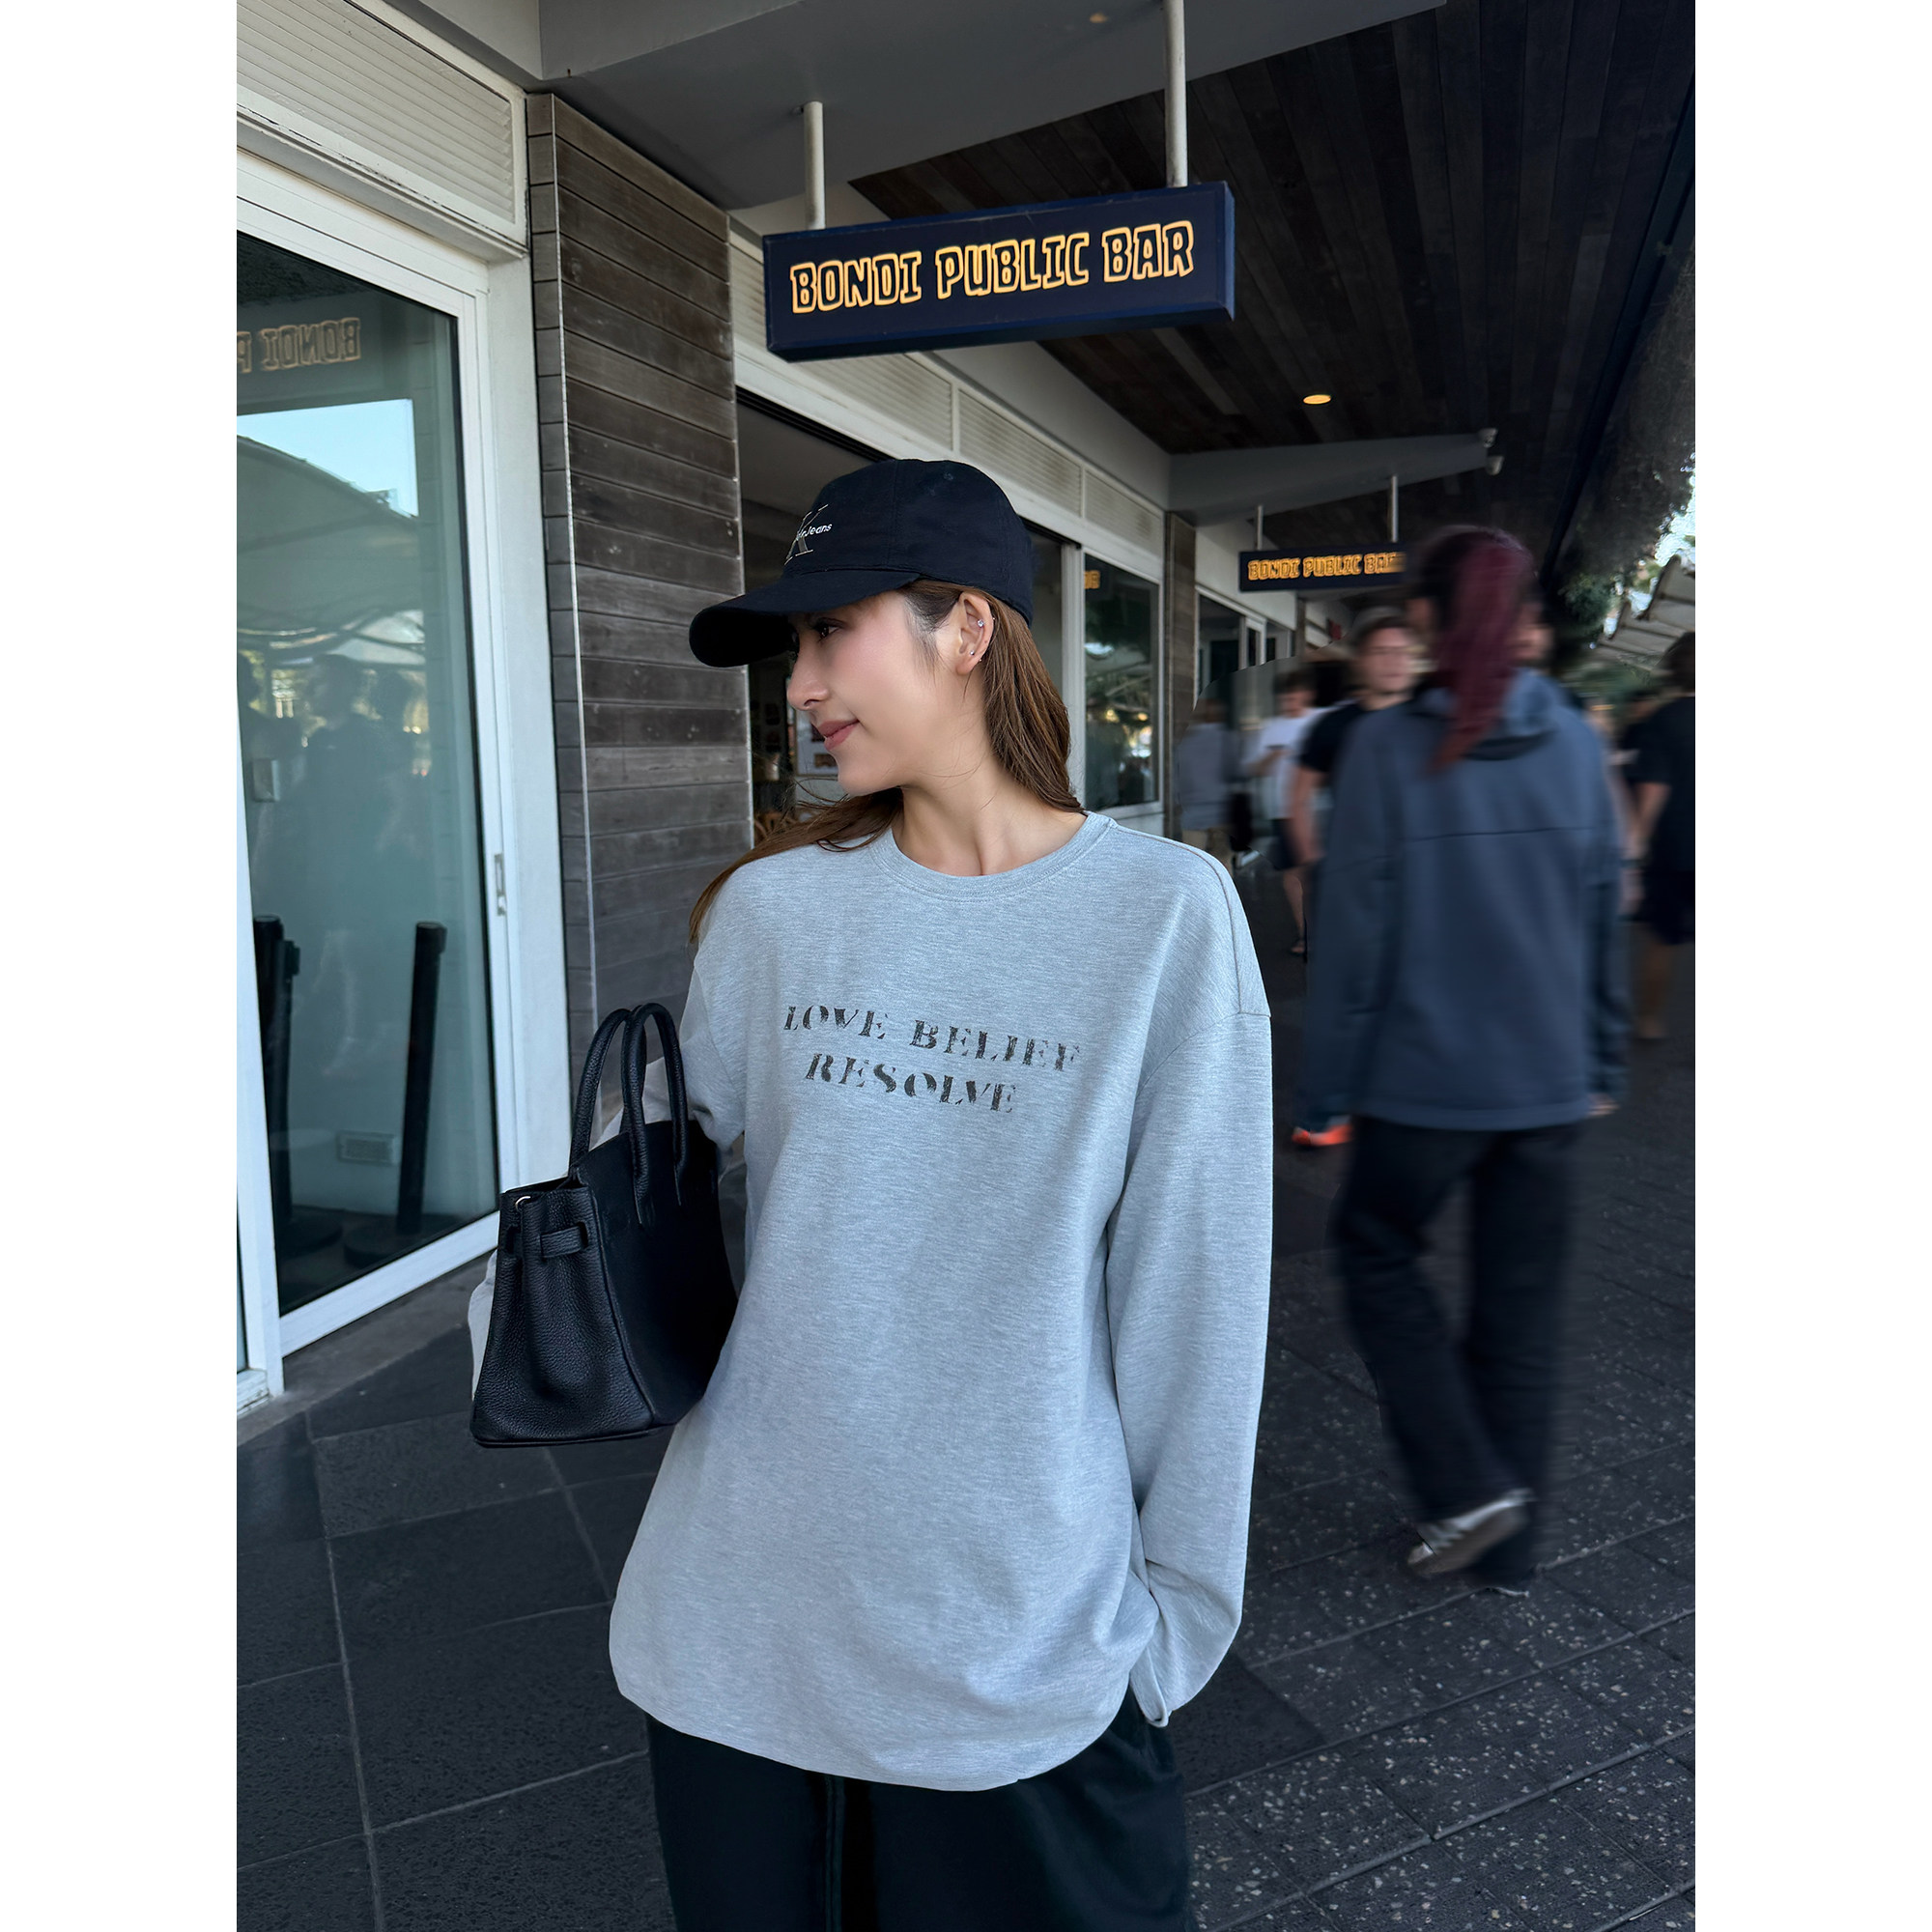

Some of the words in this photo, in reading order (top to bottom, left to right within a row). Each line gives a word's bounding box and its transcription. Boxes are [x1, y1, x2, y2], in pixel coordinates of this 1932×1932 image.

[790, 251, 922, 314] BONDI
[935, 233, 1090, 299] PUBLIC
[1102, 220, 1194, 283] BAR
[1248, 557, 1301, 581] BONDI
[1303, 554, 1363, 578] PUBLIC
[783, 1005, 888, 1039] LOVE
[910, 1019, 1081, 1072] BELIEF
[805, 1053, 1016, 1114] RESOLVE
